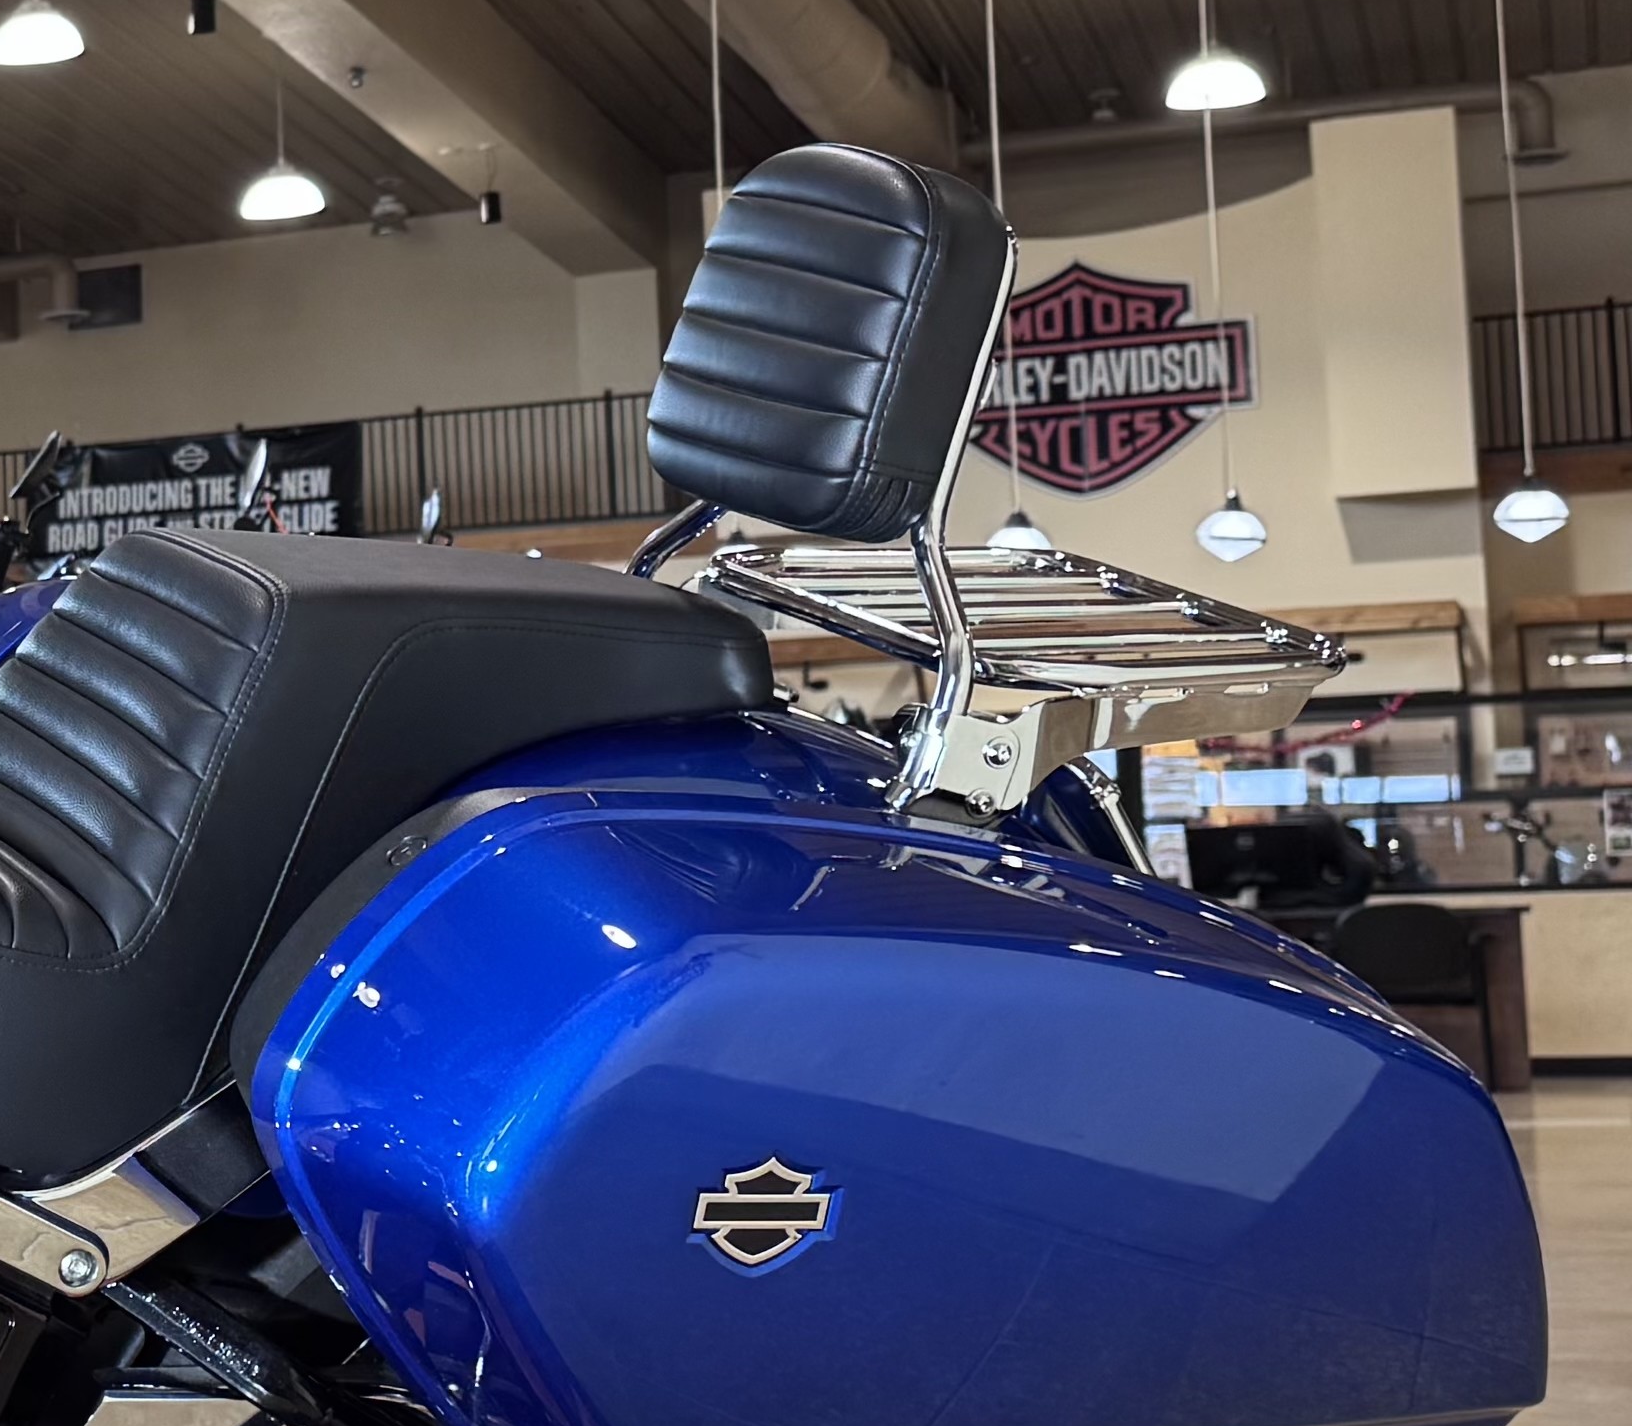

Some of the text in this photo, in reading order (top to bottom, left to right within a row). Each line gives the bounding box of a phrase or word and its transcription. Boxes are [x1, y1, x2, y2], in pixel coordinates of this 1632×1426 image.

[1009, 284, 1157, 343] MOTOR
[986, 339, 1229, 407] RLEY-DAVIDSON
[1005, 410, 1163, 474] CYCLES
[47, 520, 99, 553] ROAD
[277, 500, 339, 533] GLIDE
[58, 478, 194, 519] INTRODUCING
[196, 475, 237, 507] THE
